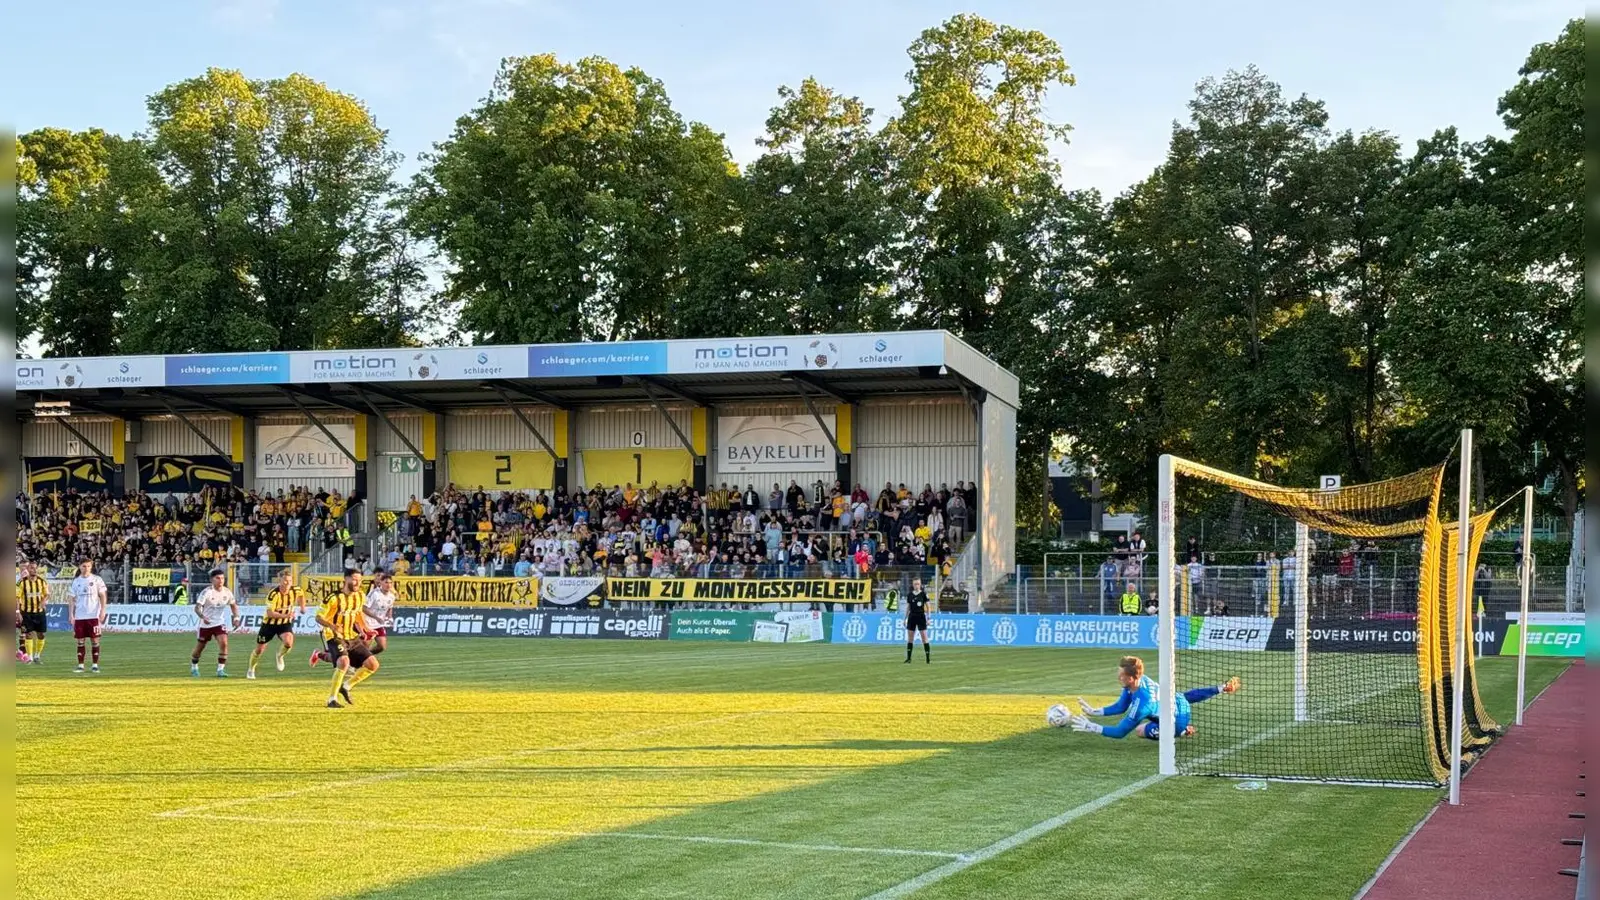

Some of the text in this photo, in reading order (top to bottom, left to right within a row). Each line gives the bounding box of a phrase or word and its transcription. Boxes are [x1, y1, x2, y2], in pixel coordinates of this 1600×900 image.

[696, 344, 788, 359] motion
[859, 354, 902, 363] schlaeger
[314, 356, 396, 369] motion
[541, 354, 649, 366] schlaeger.com/karriere
[464, 366, 502, 375] schlaeger
[728, 445, 825, 464] BAYREUTH
[495, 456, 511, 484] 2
[633, 454, 641, 484] 1
[1326, 478, 1336, 489] P
[480, 582, 513, 602] HERZ
[612, 581, 865, 600] NEIN ZU MONTAGSSPIELEN!
[487, 614, 544, 633] capelli
[604, 615, 663, 636] capelli
[1055, 620, 1139, 632] BAYREUTHER
[1054, 632, 1139, 644] BRAUHAUS
[1226, 630, 1260, 643] cep
[1286, 629, 1349, 641] RCOVER
[1354, 630, 1387, 641] WITH
[1543, 632, 1581, 648] cep
